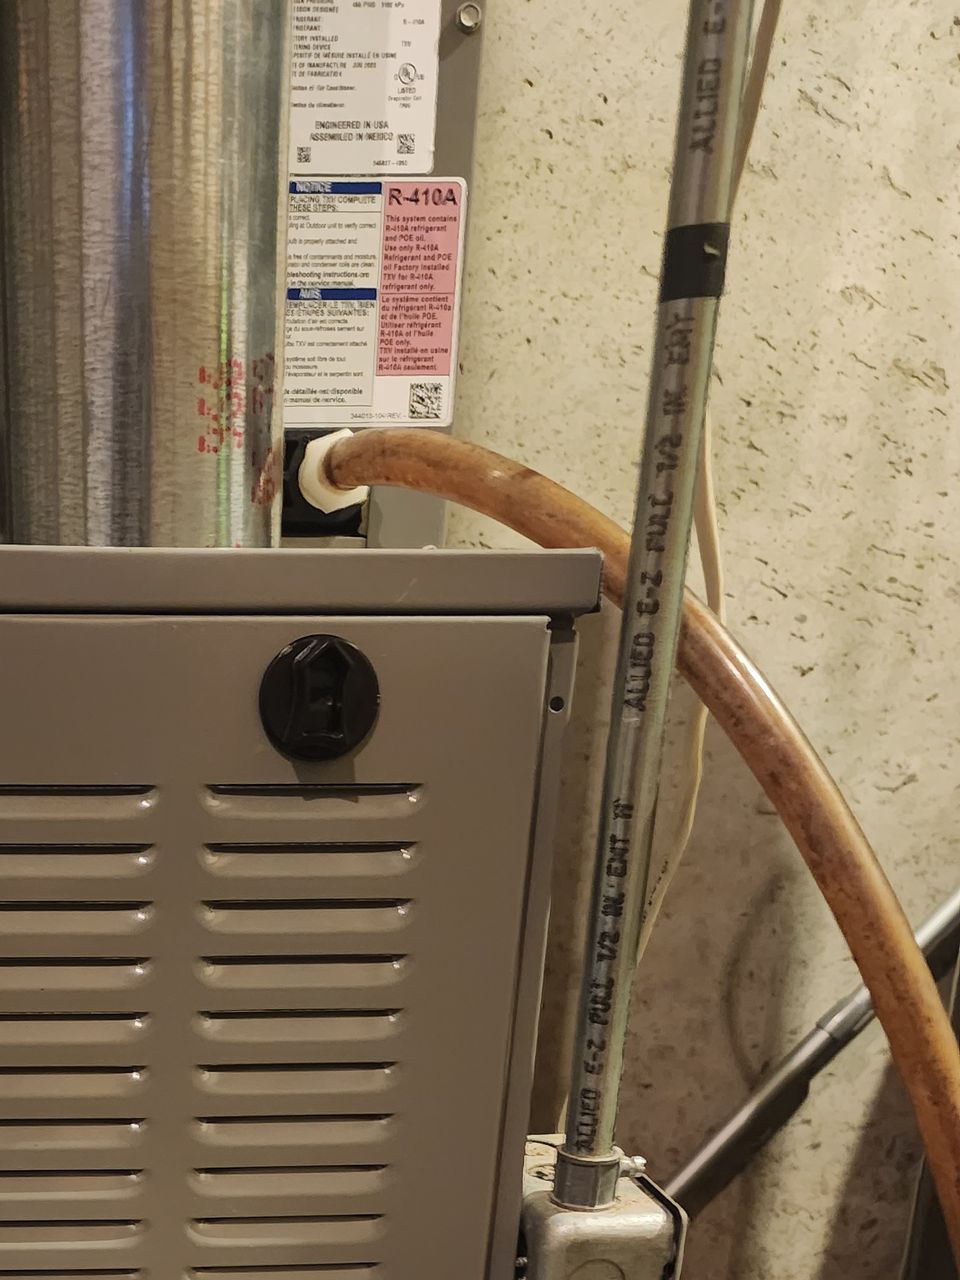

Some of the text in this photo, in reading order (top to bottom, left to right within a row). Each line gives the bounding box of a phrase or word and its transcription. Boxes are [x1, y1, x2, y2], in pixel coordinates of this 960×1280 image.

[689, 58, 721, 153] ALLIED
[315, 121, 389, 129] ENGINEERED IN USA
[310, 133, 393, 141] ASSEMBLED IN MEXICO
[389, 188, 457, 205] R-410A
[403, 215, 426, 223] system
[411, 225, 447, 233] refrigerant
[399, 244, 413, 252] only
[394, 264, 418, 272] Factory
[623, 631, 655, 712] ALLIED
[645, 490, 674, 552] PULL
[596, 931, 621, 963] 1/2
[588, 978, 615, 1026] PULL
